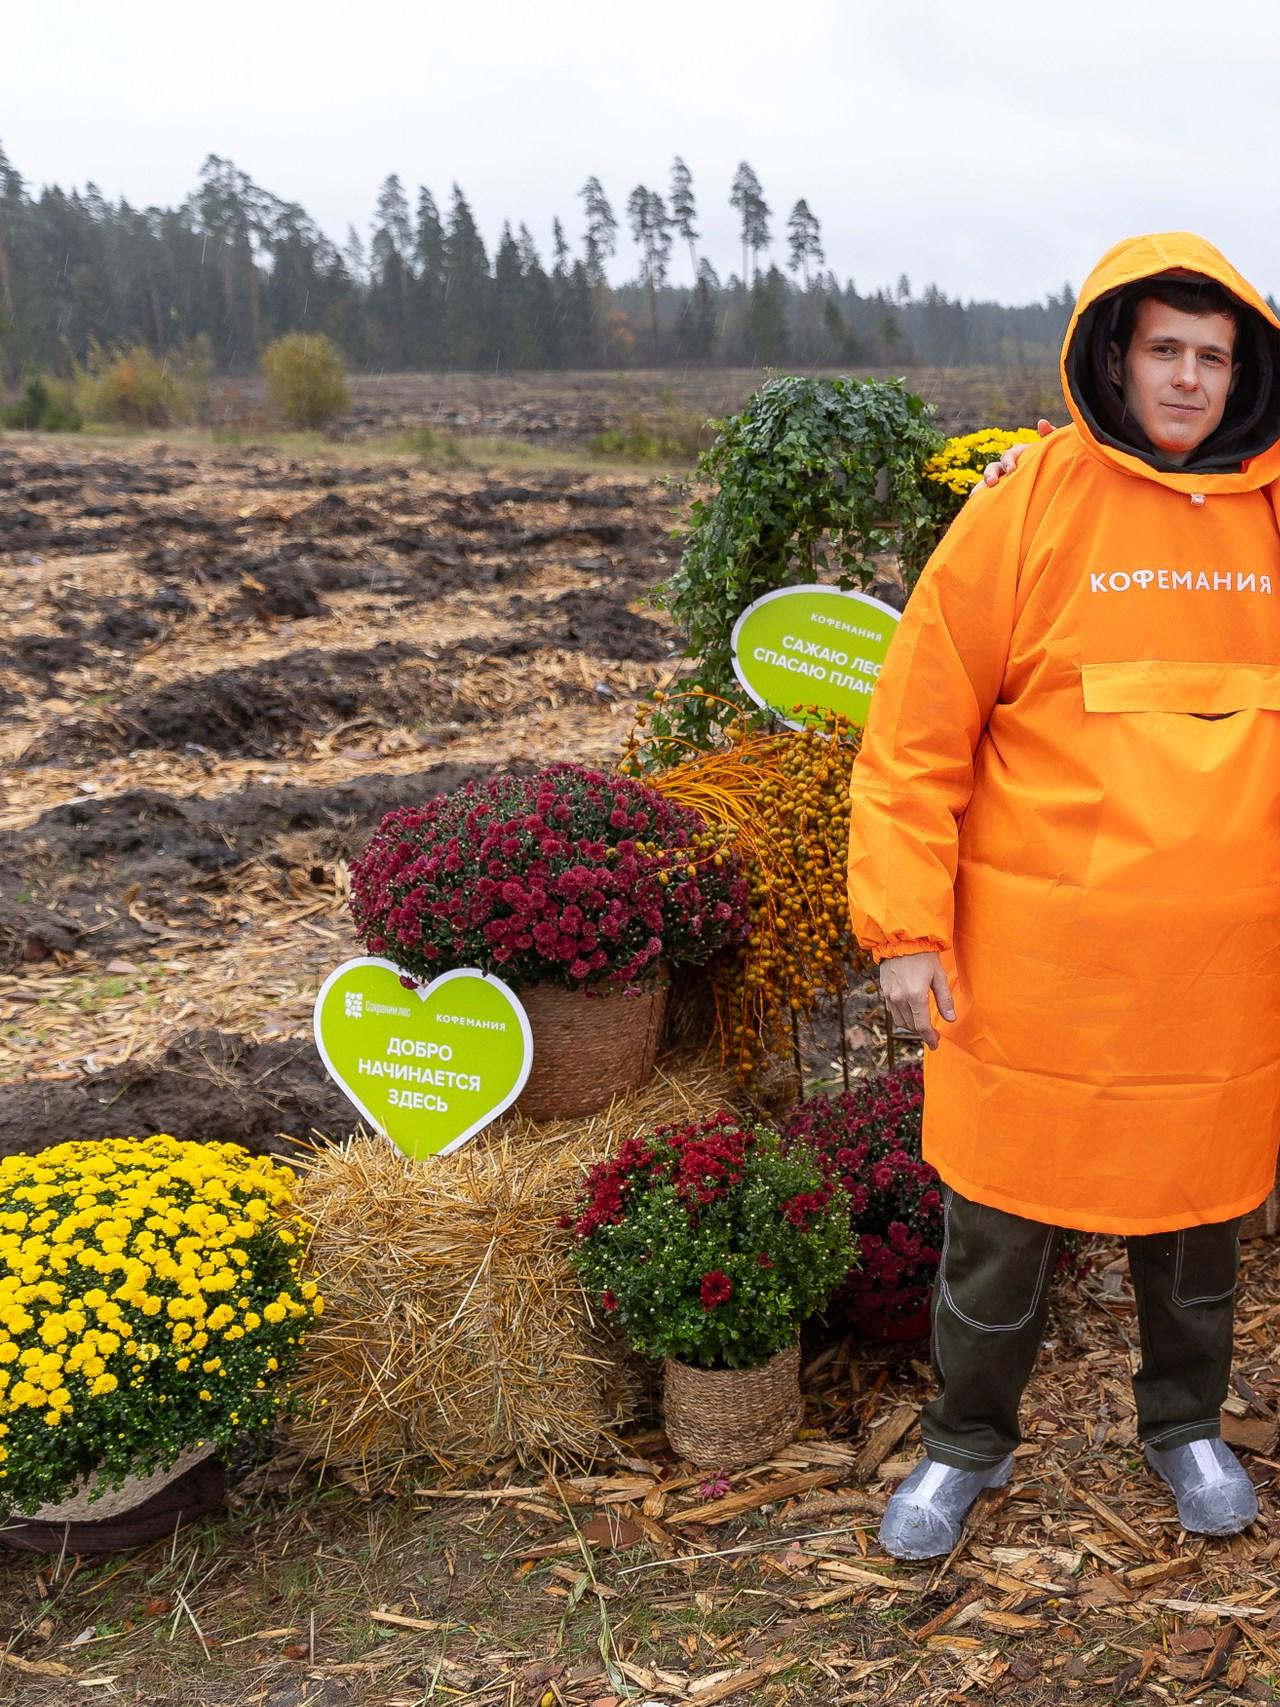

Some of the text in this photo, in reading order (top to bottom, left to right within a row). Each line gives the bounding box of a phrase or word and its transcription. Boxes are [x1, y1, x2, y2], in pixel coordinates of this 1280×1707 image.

[1089, 569, 1272, 594] КОФЕМАНИЯ
[811, 613, 882, 642] КОФЕМАНИЯ
[782, 636, 848, 666] САЖАЮ
[753, 647, 875, 696] СПАСАЮ ПЛАН
[435, 1013, 506, 1032] КОФЕМАНИЯ
[386, 1037, 453, 1061] ДОБРО
[358, 1058, 481, 1092] НАЧИНАЕТСЯ
[387, 1088, 448, 1112] ЗДЕСЬ
